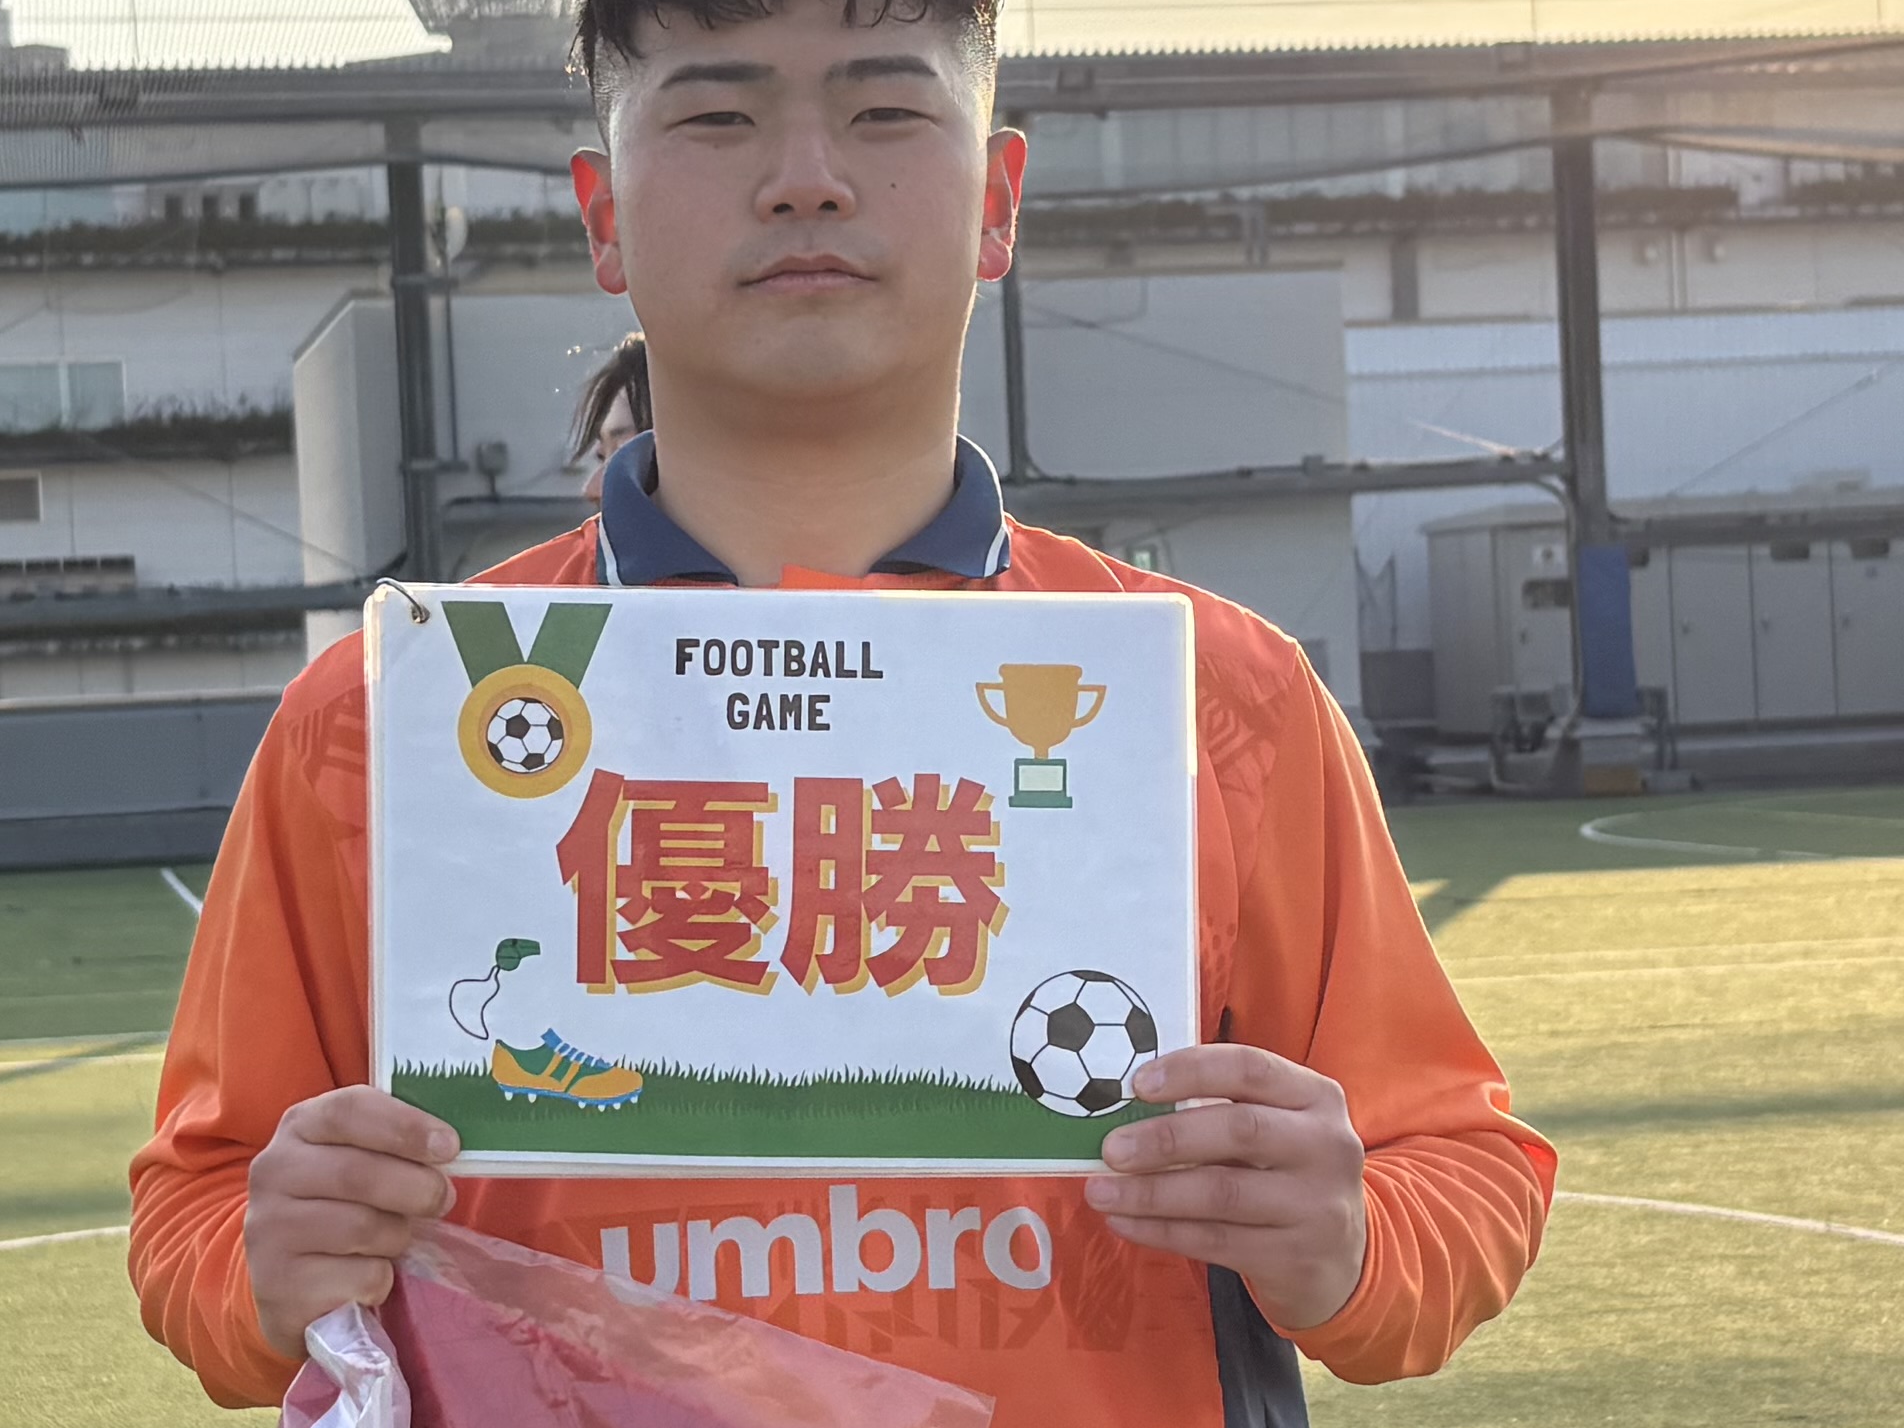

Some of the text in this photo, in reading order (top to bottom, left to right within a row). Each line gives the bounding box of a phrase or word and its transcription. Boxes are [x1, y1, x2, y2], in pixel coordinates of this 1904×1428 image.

[674, 638, 884, 681] FOOTBALL
[725, 692, 832, 732] GAME
[555, 769, 1010, 997] 優勝
[599, 1184, 1053, 1302] umbro
